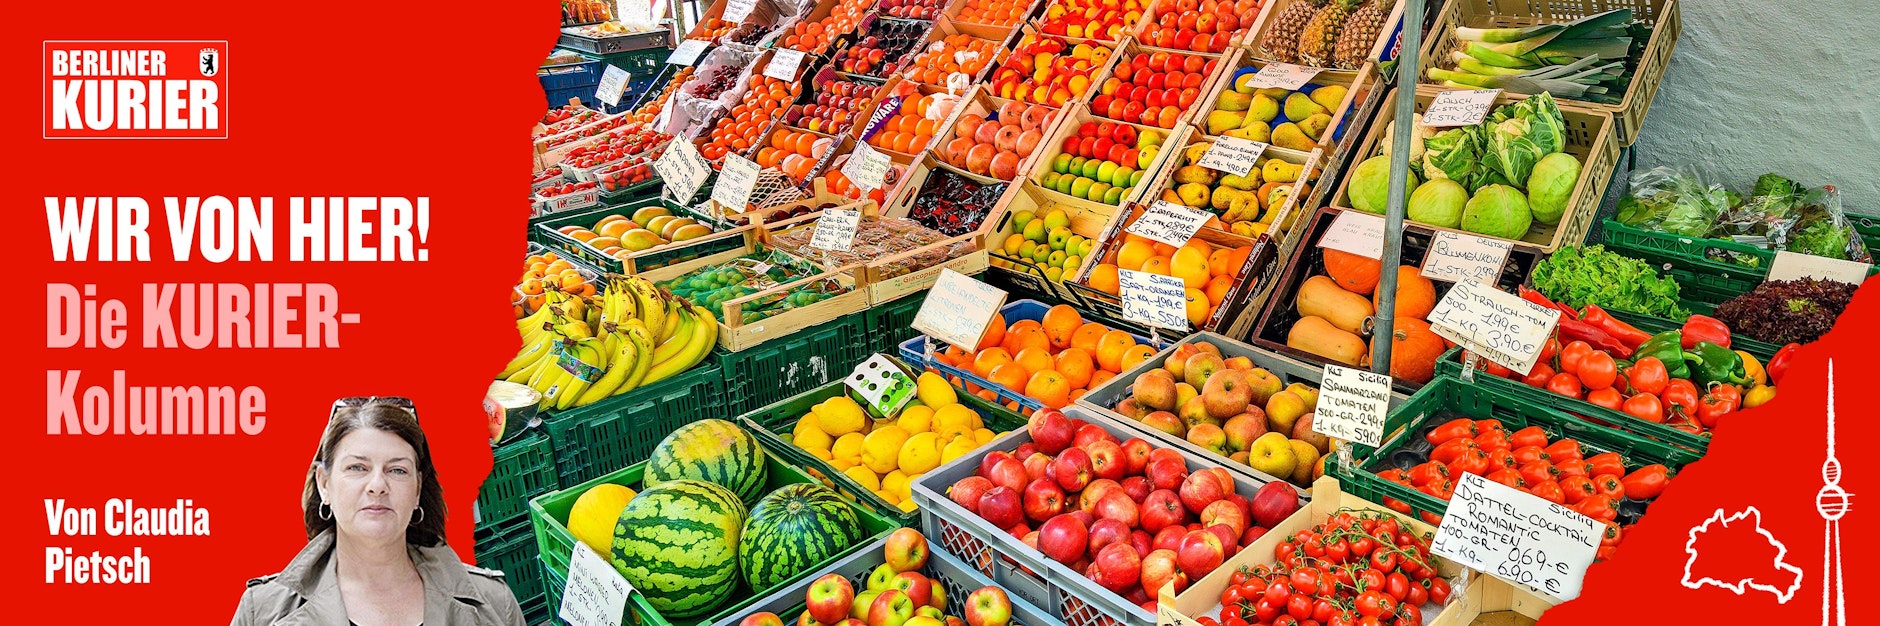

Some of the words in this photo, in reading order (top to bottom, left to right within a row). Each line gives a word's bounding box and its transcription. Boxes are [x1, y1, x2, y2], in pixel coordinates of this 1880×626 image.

[1463, 277, 1480, 288] KLI
[1212, 297, 1229, 322] Natural
[1225, 286, 1236, 299] Line
[1453, 284, 1547, 329] STRAUCH-TOM
[1322, 378, 1388, 403] SANMARZANO
[1327, 366, 1343, 377] KLI
[1358, 372, 1388, 389] Sicilia
[1323, 394, 1376, 413] TOMATEN
[1453, 483, 1594, 548] DATTEL-COCKTAIL
[1465, 473, 1486, 490] KLI
[1548, 502, 1594, 530] Sicilia
[1449, 513, 1521, 548] TOMATEN
[1467, 502, 1541, 542] ROMANTIC
